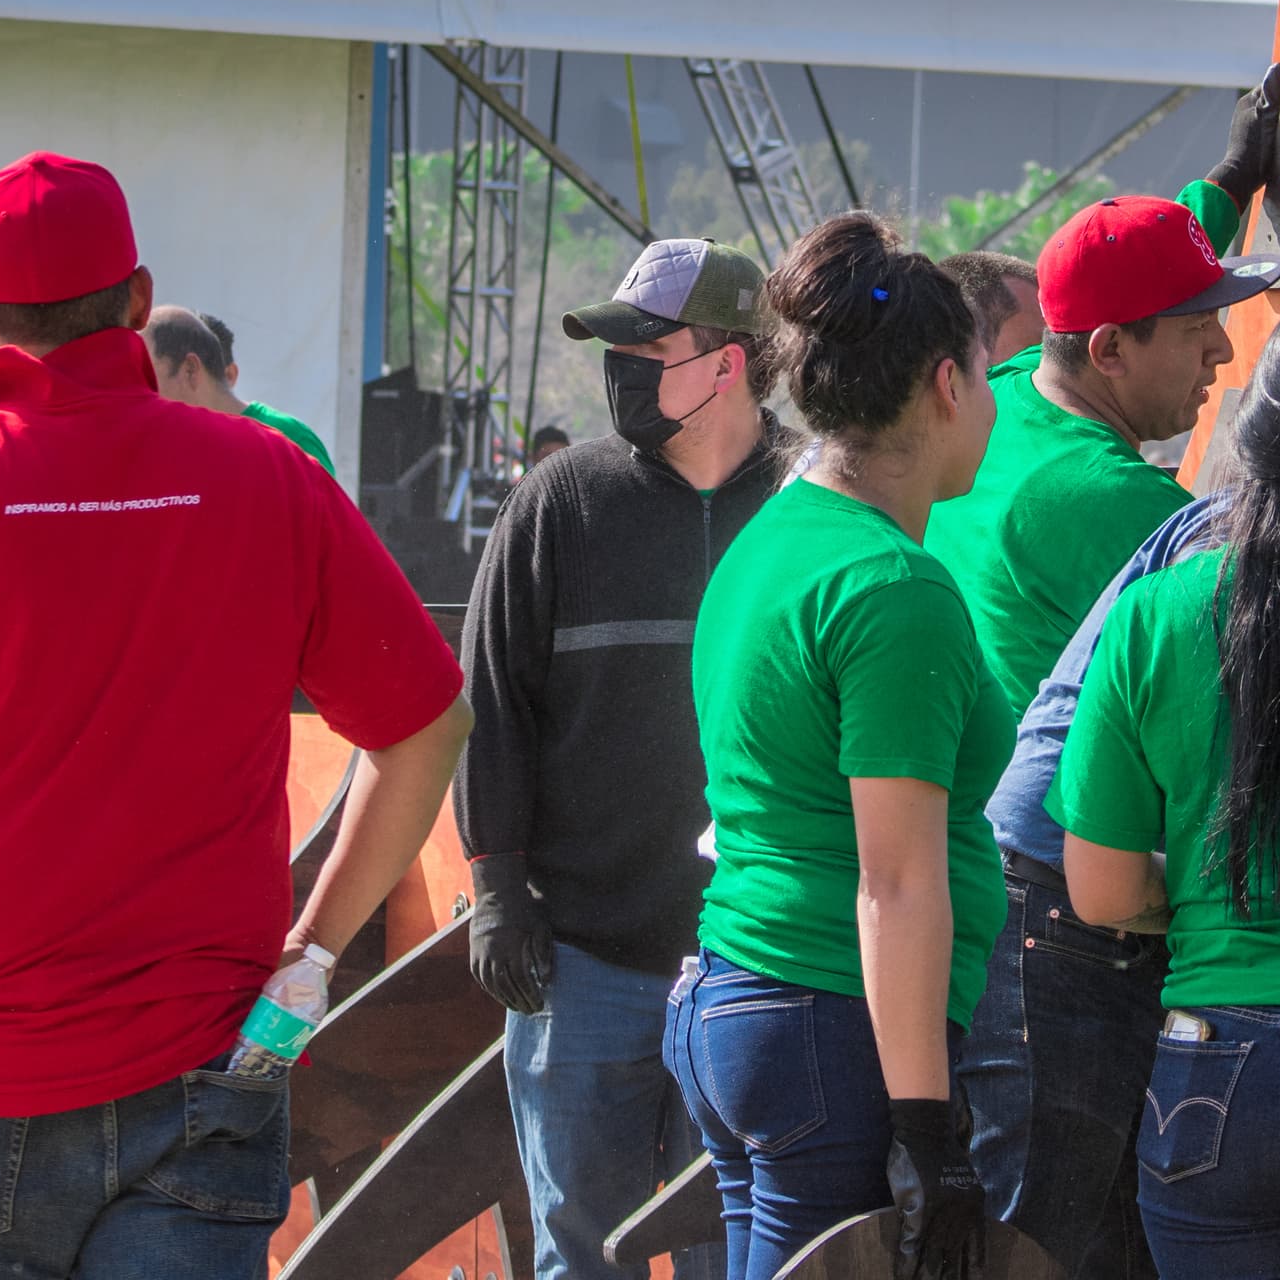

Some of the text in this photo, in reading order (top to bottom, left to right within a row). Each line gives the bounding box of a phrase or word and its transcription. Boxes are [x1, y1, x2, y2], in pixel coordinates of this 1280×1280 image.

[4, 502, 67, 515] INSPIRAMOS
[67, 502, 77, 512] A
[78, 501, 99, 512] SER
[122, 494, 201, 510] PRODUCTIVOS
